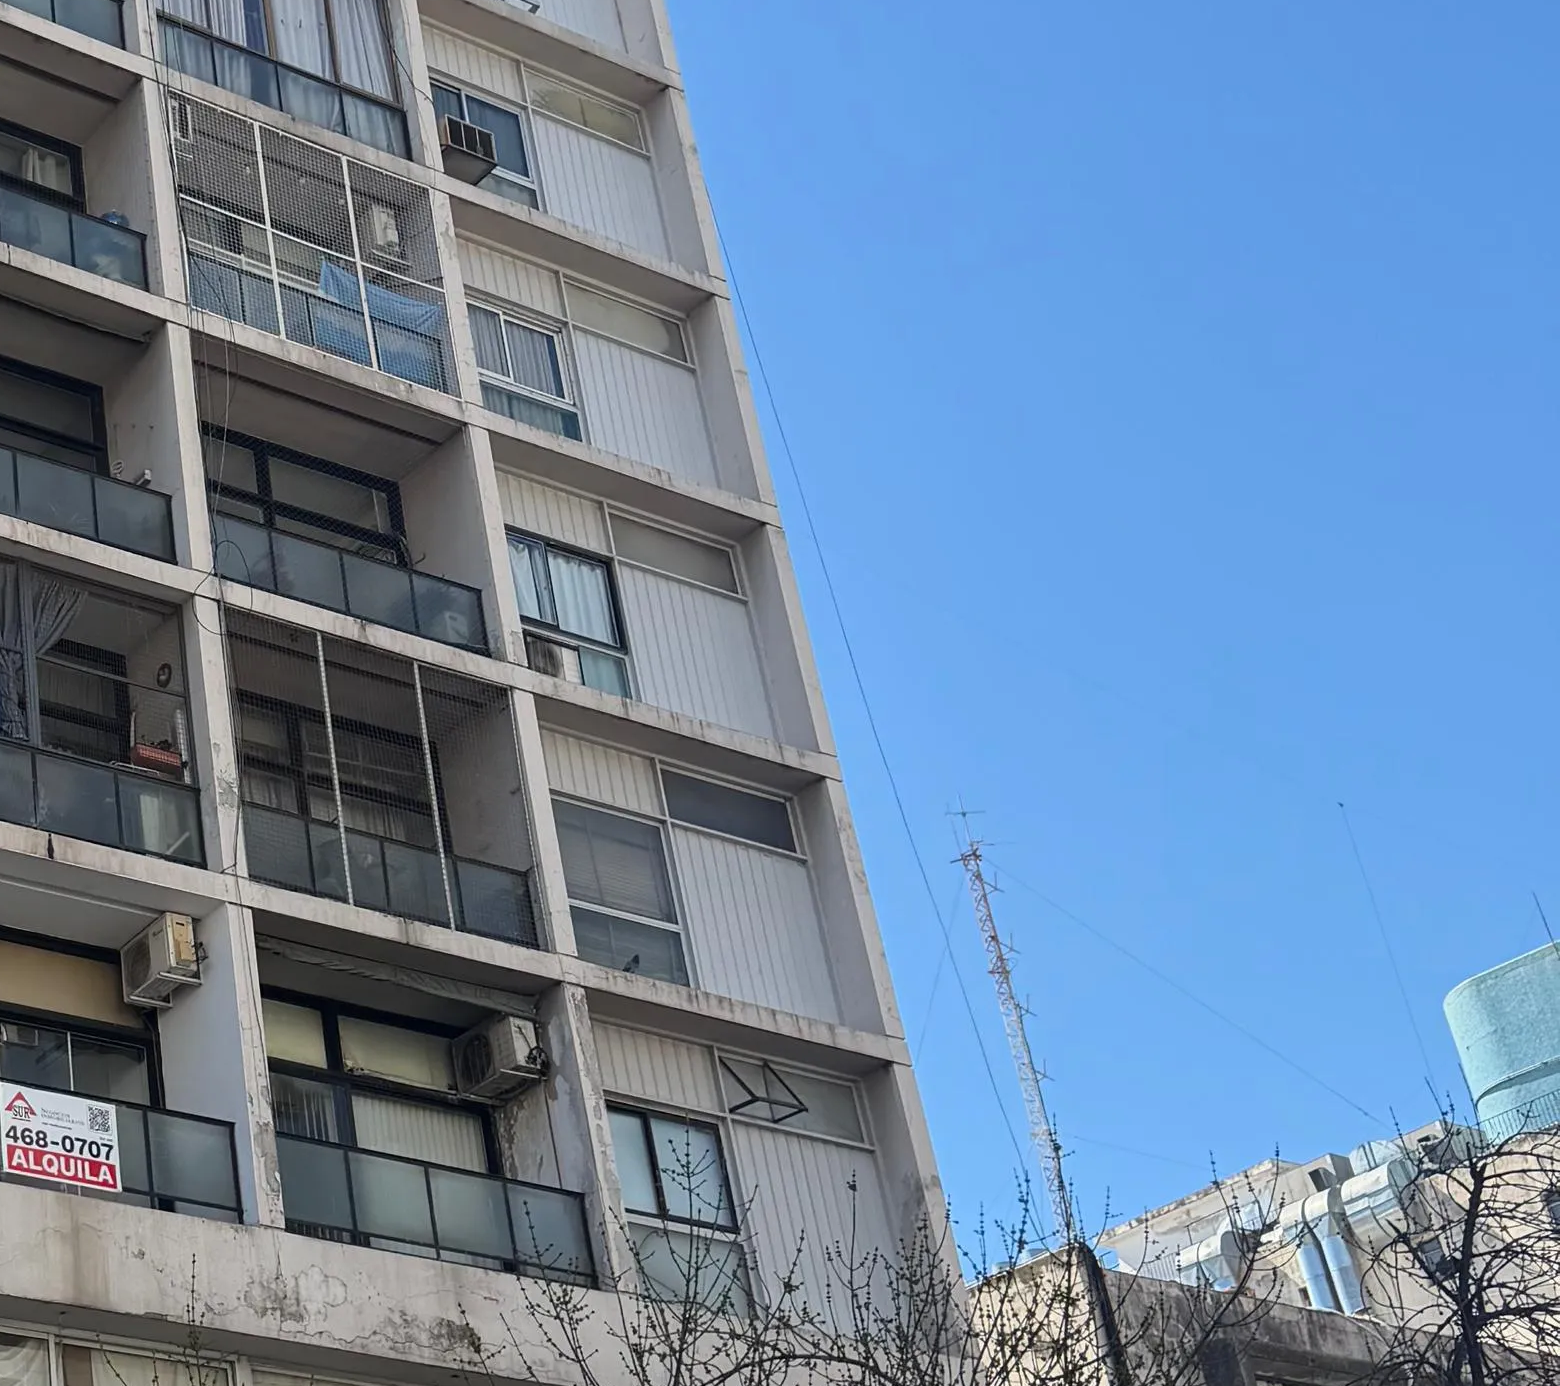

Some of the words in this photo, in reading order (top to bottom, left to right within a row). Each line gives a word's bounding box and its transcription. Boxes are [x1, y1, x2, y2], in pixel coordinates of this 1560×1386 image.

[12, 1104, 31, 1119] SUR
[5, 1125, 114, 1161] 468-0707
[11, 1148, 115, 1185] ALQUILA
